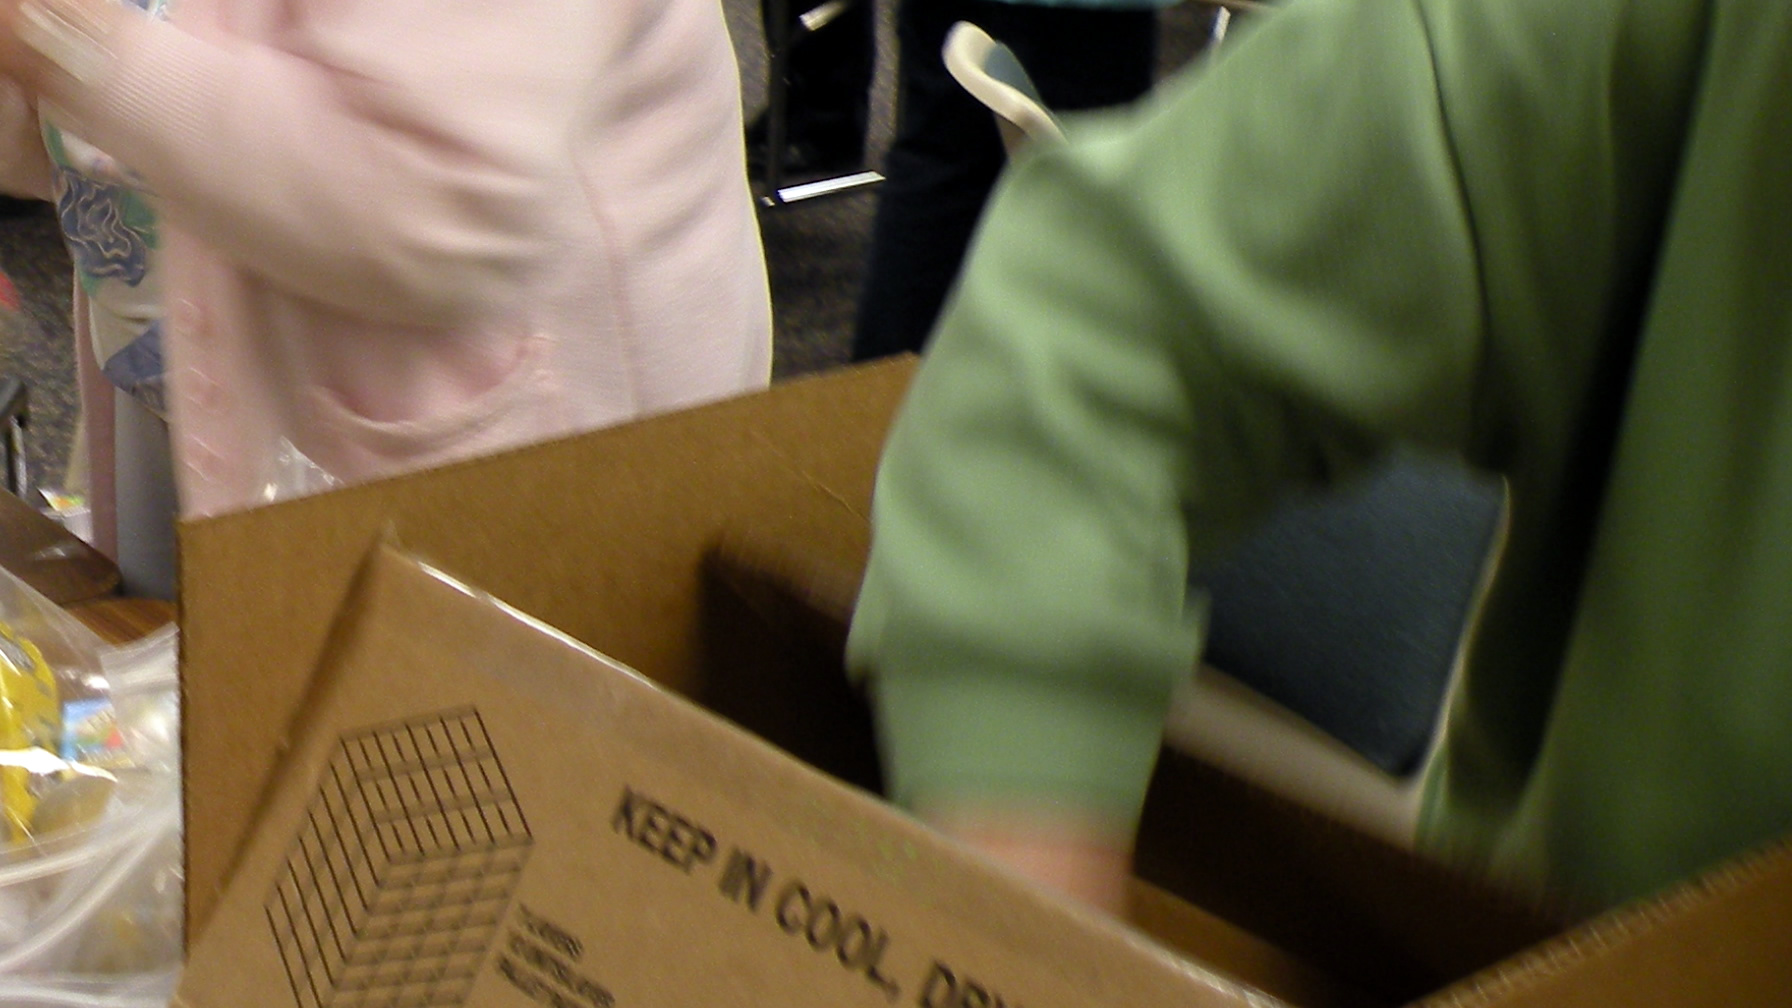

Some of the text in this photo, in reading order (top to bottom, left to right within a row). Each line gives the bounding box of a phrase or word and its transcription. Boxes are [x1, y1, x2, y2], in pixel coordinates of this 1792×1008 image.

[611, 785, 717, 876] KEEP
[718, 846, 774, 913] IN
[773, 878, 902, 1003] COOL,
